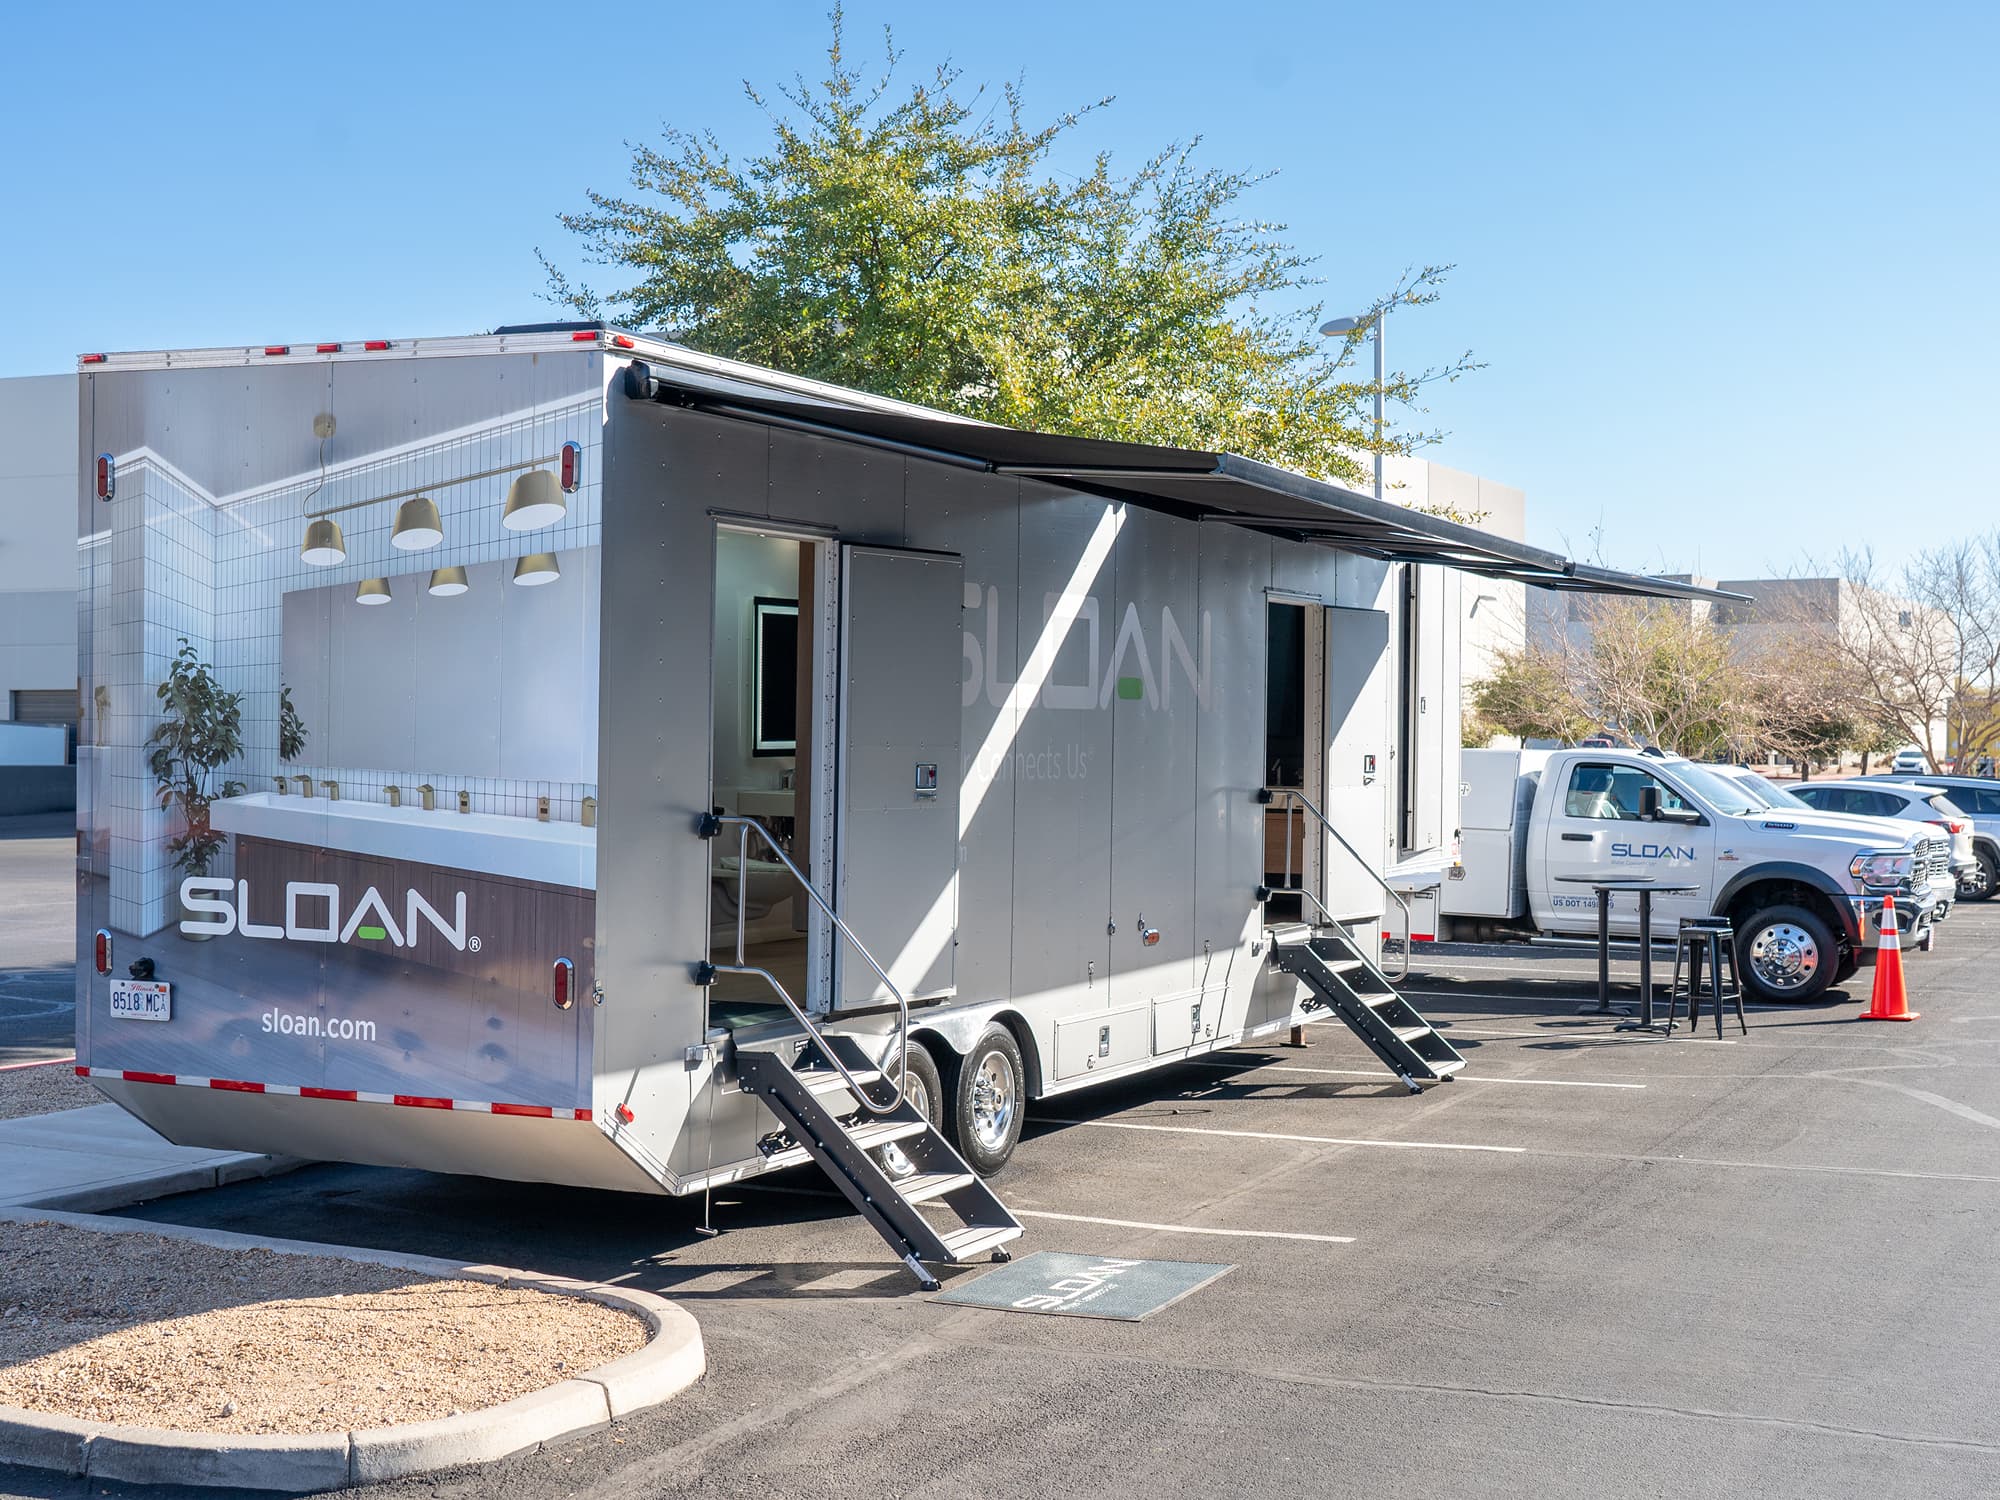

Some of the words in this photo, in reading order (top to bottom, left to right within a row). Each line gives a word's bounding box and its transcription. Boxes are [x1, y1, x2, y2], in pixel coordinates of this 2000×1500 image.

[1553, 899, 1563, 907] US
[1565, 900, 1580, 908] DOT
[113, 991, 140, 1011] 8518
[146, 993, 160, 1012] MC
[262, 1008, 376, 1041] sloan.com
